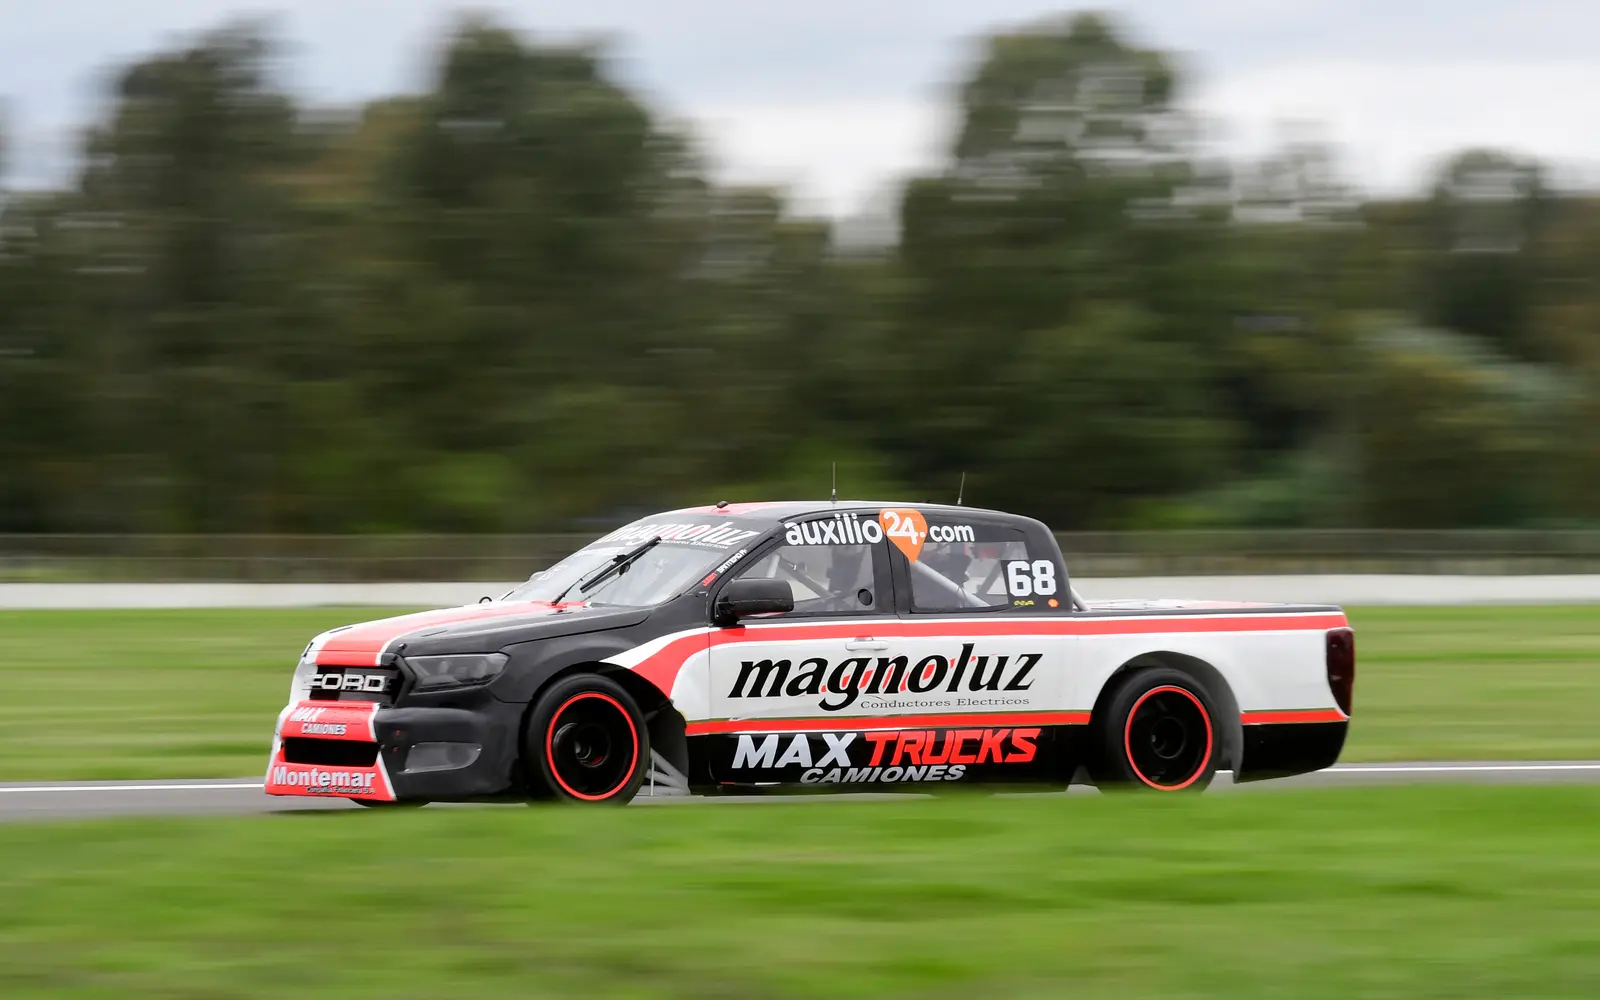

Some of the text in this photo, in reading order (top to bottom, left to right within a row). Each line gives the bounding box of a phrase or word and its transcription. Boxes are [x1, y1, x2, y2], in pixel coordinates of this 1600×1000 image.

[1007, 560, 1057, 597] 68
[305, 673, 387, 692] FORD
[728, 643, 1044, 711] magnoluz
[860, 697, 1030, 709] Conductores Electricos
[290, 706, 327, 722] MAX
[301, 722, 348, 735] CAMIONES
[731, 728, 1042, 769] MAX TRUCKS
[273, 766, 376, 787] Montemar
[800, 764, 967, 784] CAMIONES
